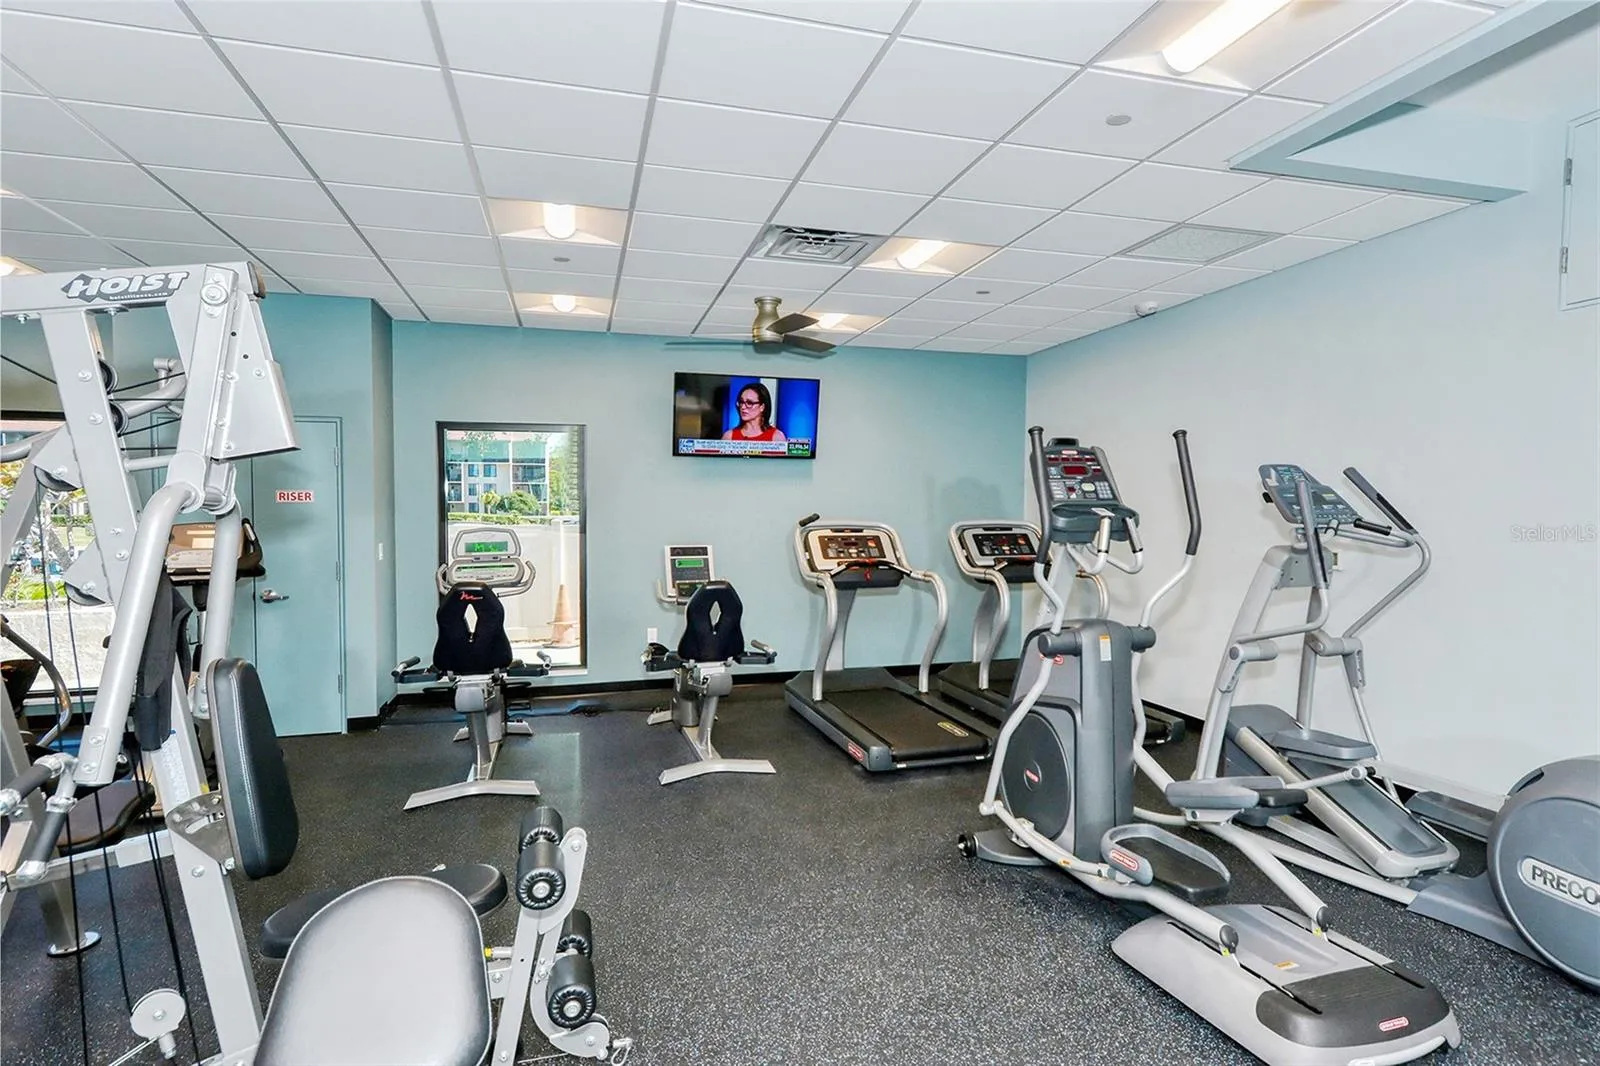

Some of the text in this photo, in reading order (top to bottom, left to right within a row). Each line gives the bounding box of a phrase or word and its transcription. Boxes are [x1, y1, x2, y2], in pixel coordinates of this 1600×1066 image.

[67, 271, 189, 298] HOIST
[278, 491, 312, 501] RISER
[1531, 864, 1600, 906] PRECO
